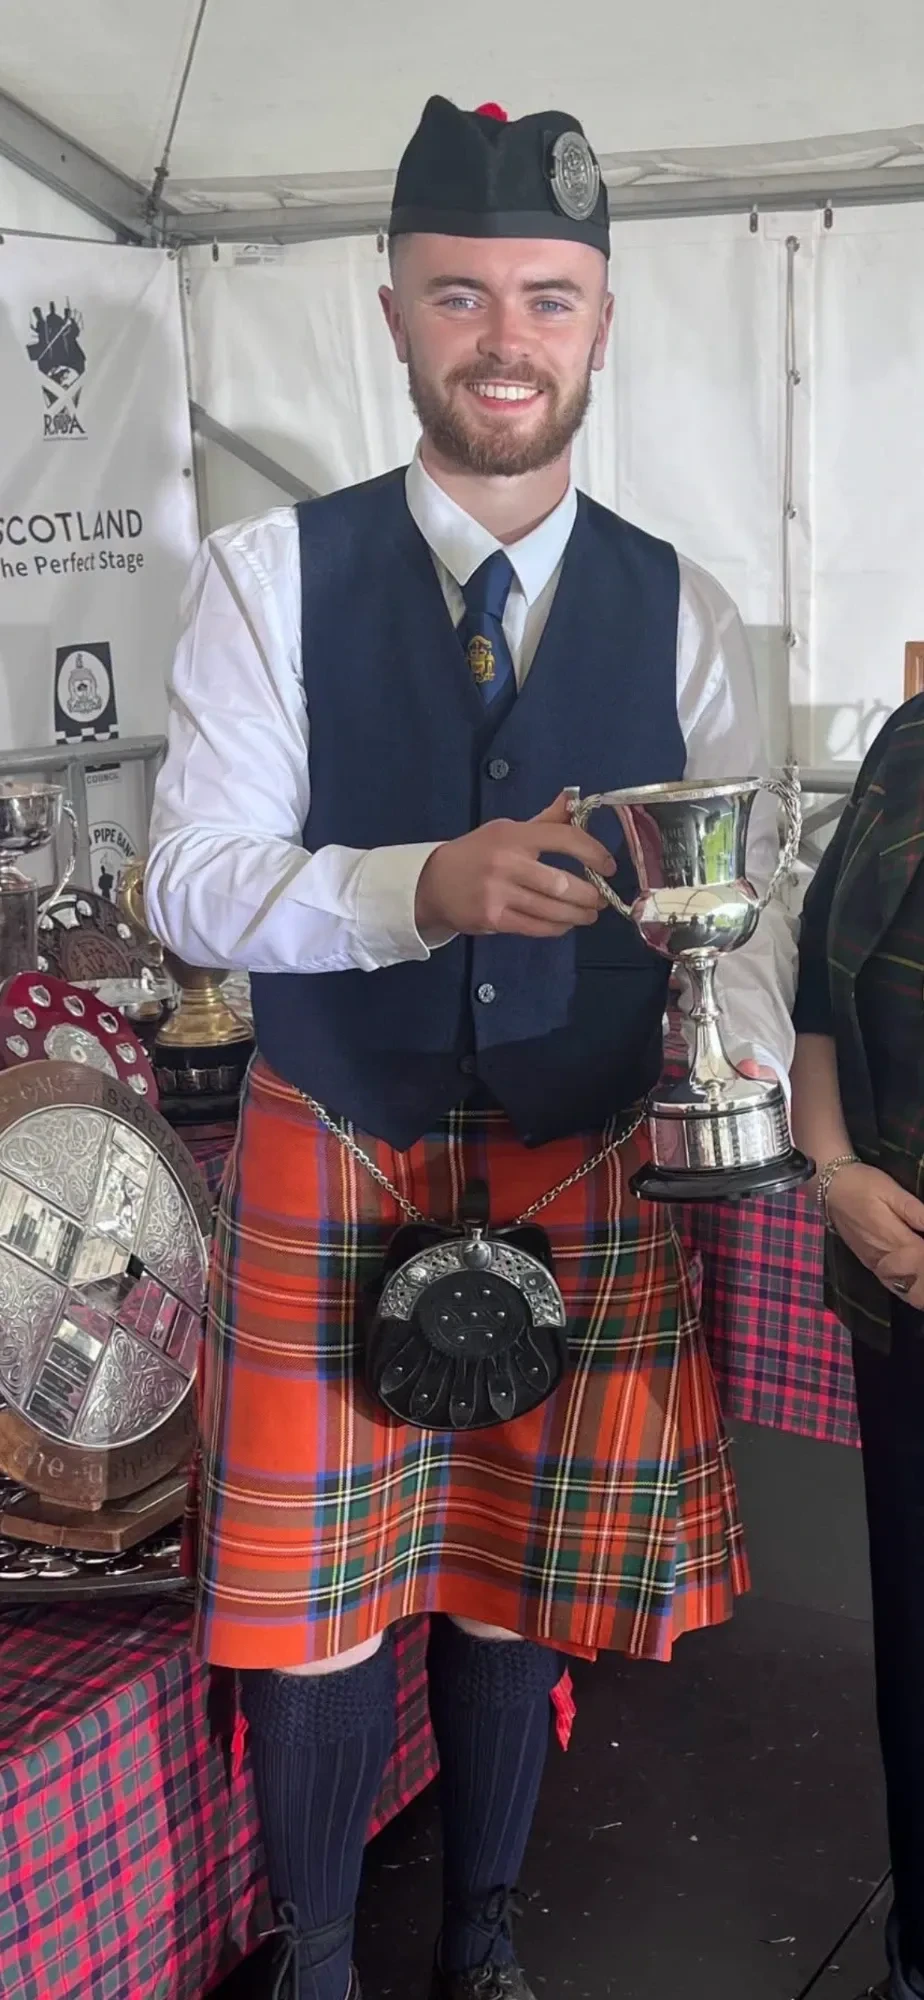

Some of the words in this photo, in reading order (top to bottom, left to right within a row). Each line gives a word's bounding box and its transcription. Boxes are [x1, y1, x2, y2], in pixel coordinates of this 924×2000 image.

[0, 558, 28, 578] he
[34, 552, 95, 575] Perfect
[99, 550, 144, 574] Stage
[94, 827, 117, 844] PIPE
